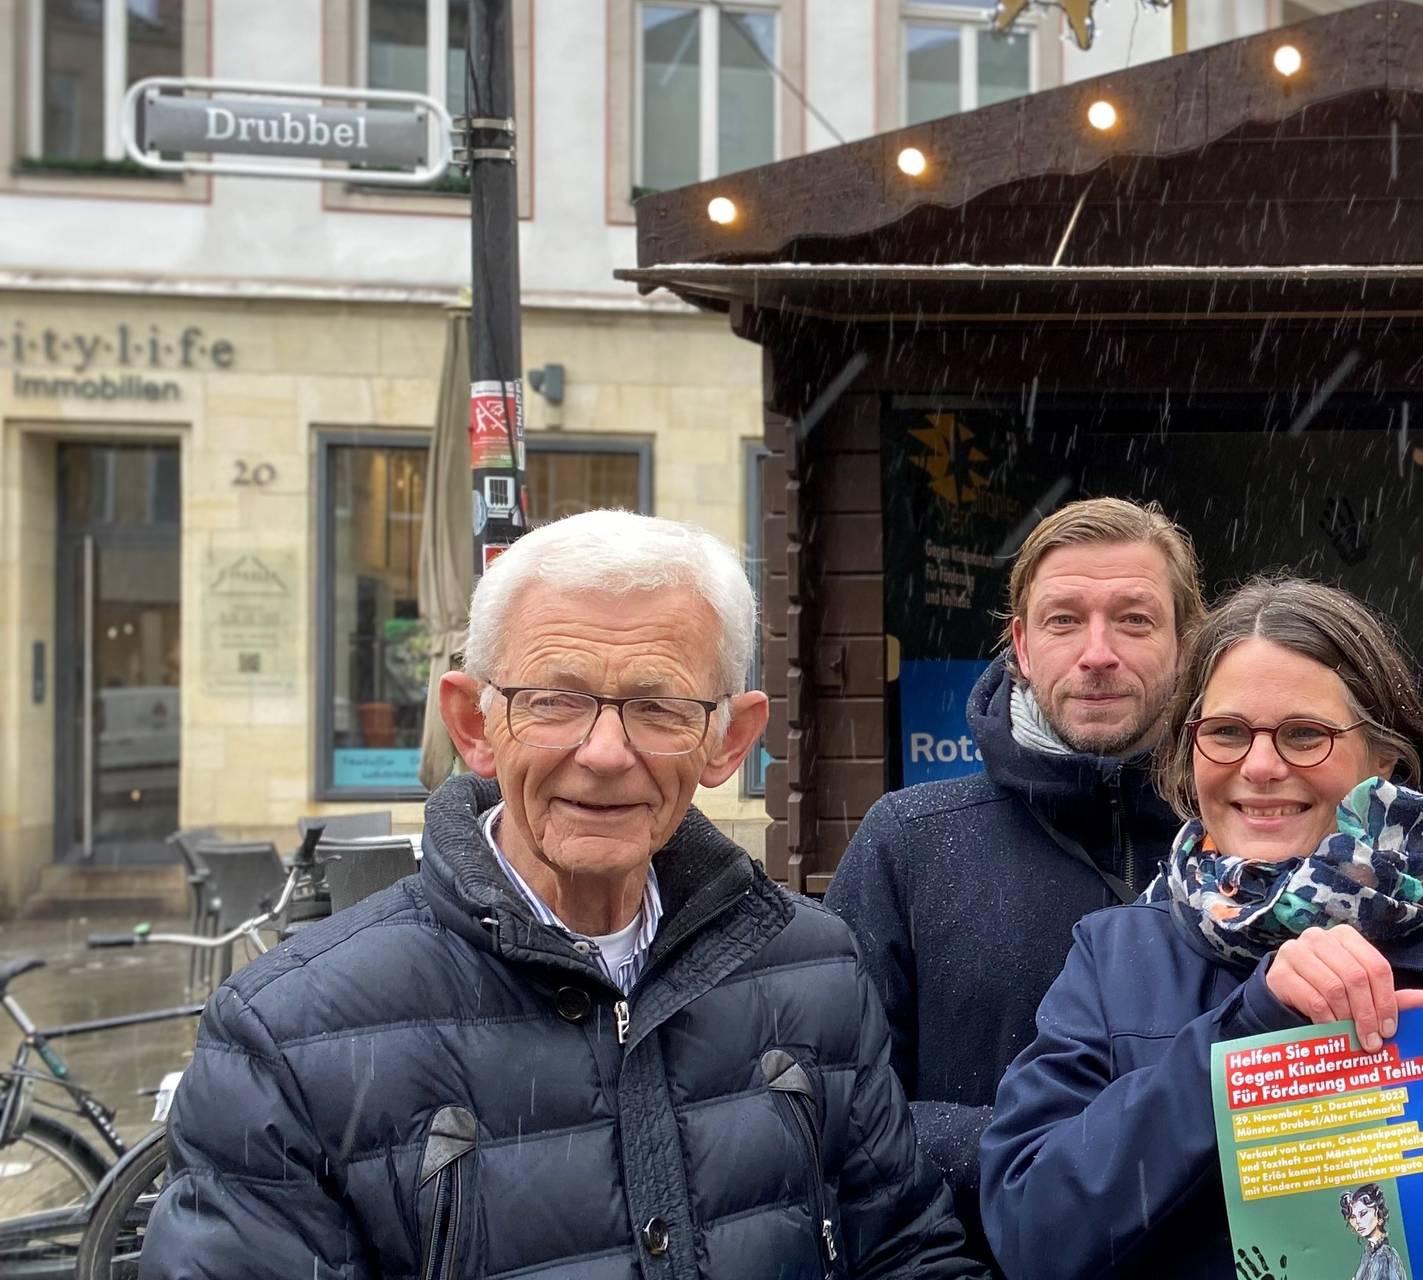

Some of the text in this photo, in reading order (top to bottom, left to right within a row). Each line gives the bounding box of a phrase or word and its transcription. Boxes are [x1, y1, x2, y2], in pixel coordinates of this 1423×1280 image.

[205, 107, 368, 148] Drubbel
[14, 372, 180, 400] Immobilien
[232, 459, 276, 486] 20
[1230, 1038, 1345, 1069] Helfen Sie mit!
[1231, 1050, 1394, 1087] Gegen Kinderarmut.
[1232, 1088, 1258, 1105] Für
[1262, 1077, 1346, 1100] Förderung
[1350, 1067, 1380, 1086] und
[1235, 1116, 1251, 1126] 29.
[1253, 1109, 1302, 1122] November
[1312, 1104, 1326, 1114] 21.
[1328, 1096, 1377, 1111] Dezember
[1379, 1090, 1405, 1102] 2023
[1237, 1104, 1401, 1137] Münster, Drubbel/Alter Fischmarkt
[1240, 1126, 1417, 1160] Verkauf von Karten, Geschenkpapier
[1241, 1161, 1260, 1172] und
[1262, 1156, 1301, 1169] Textheft
[1304, 1154, 1323, 1163] zum
[1326, 1147, 1368, 1160] Märchen
[1243, 1153, 1401, 1185] Der Erlös kommt Sozialprojekten
[1245, 1187, 1260, 1196] mit
[1262, 1181, 1301, 1193] Kindern
[1303, 1176, 1321, 1186] und
[1324, 1166, 1387, 1184] Jugendlichen
